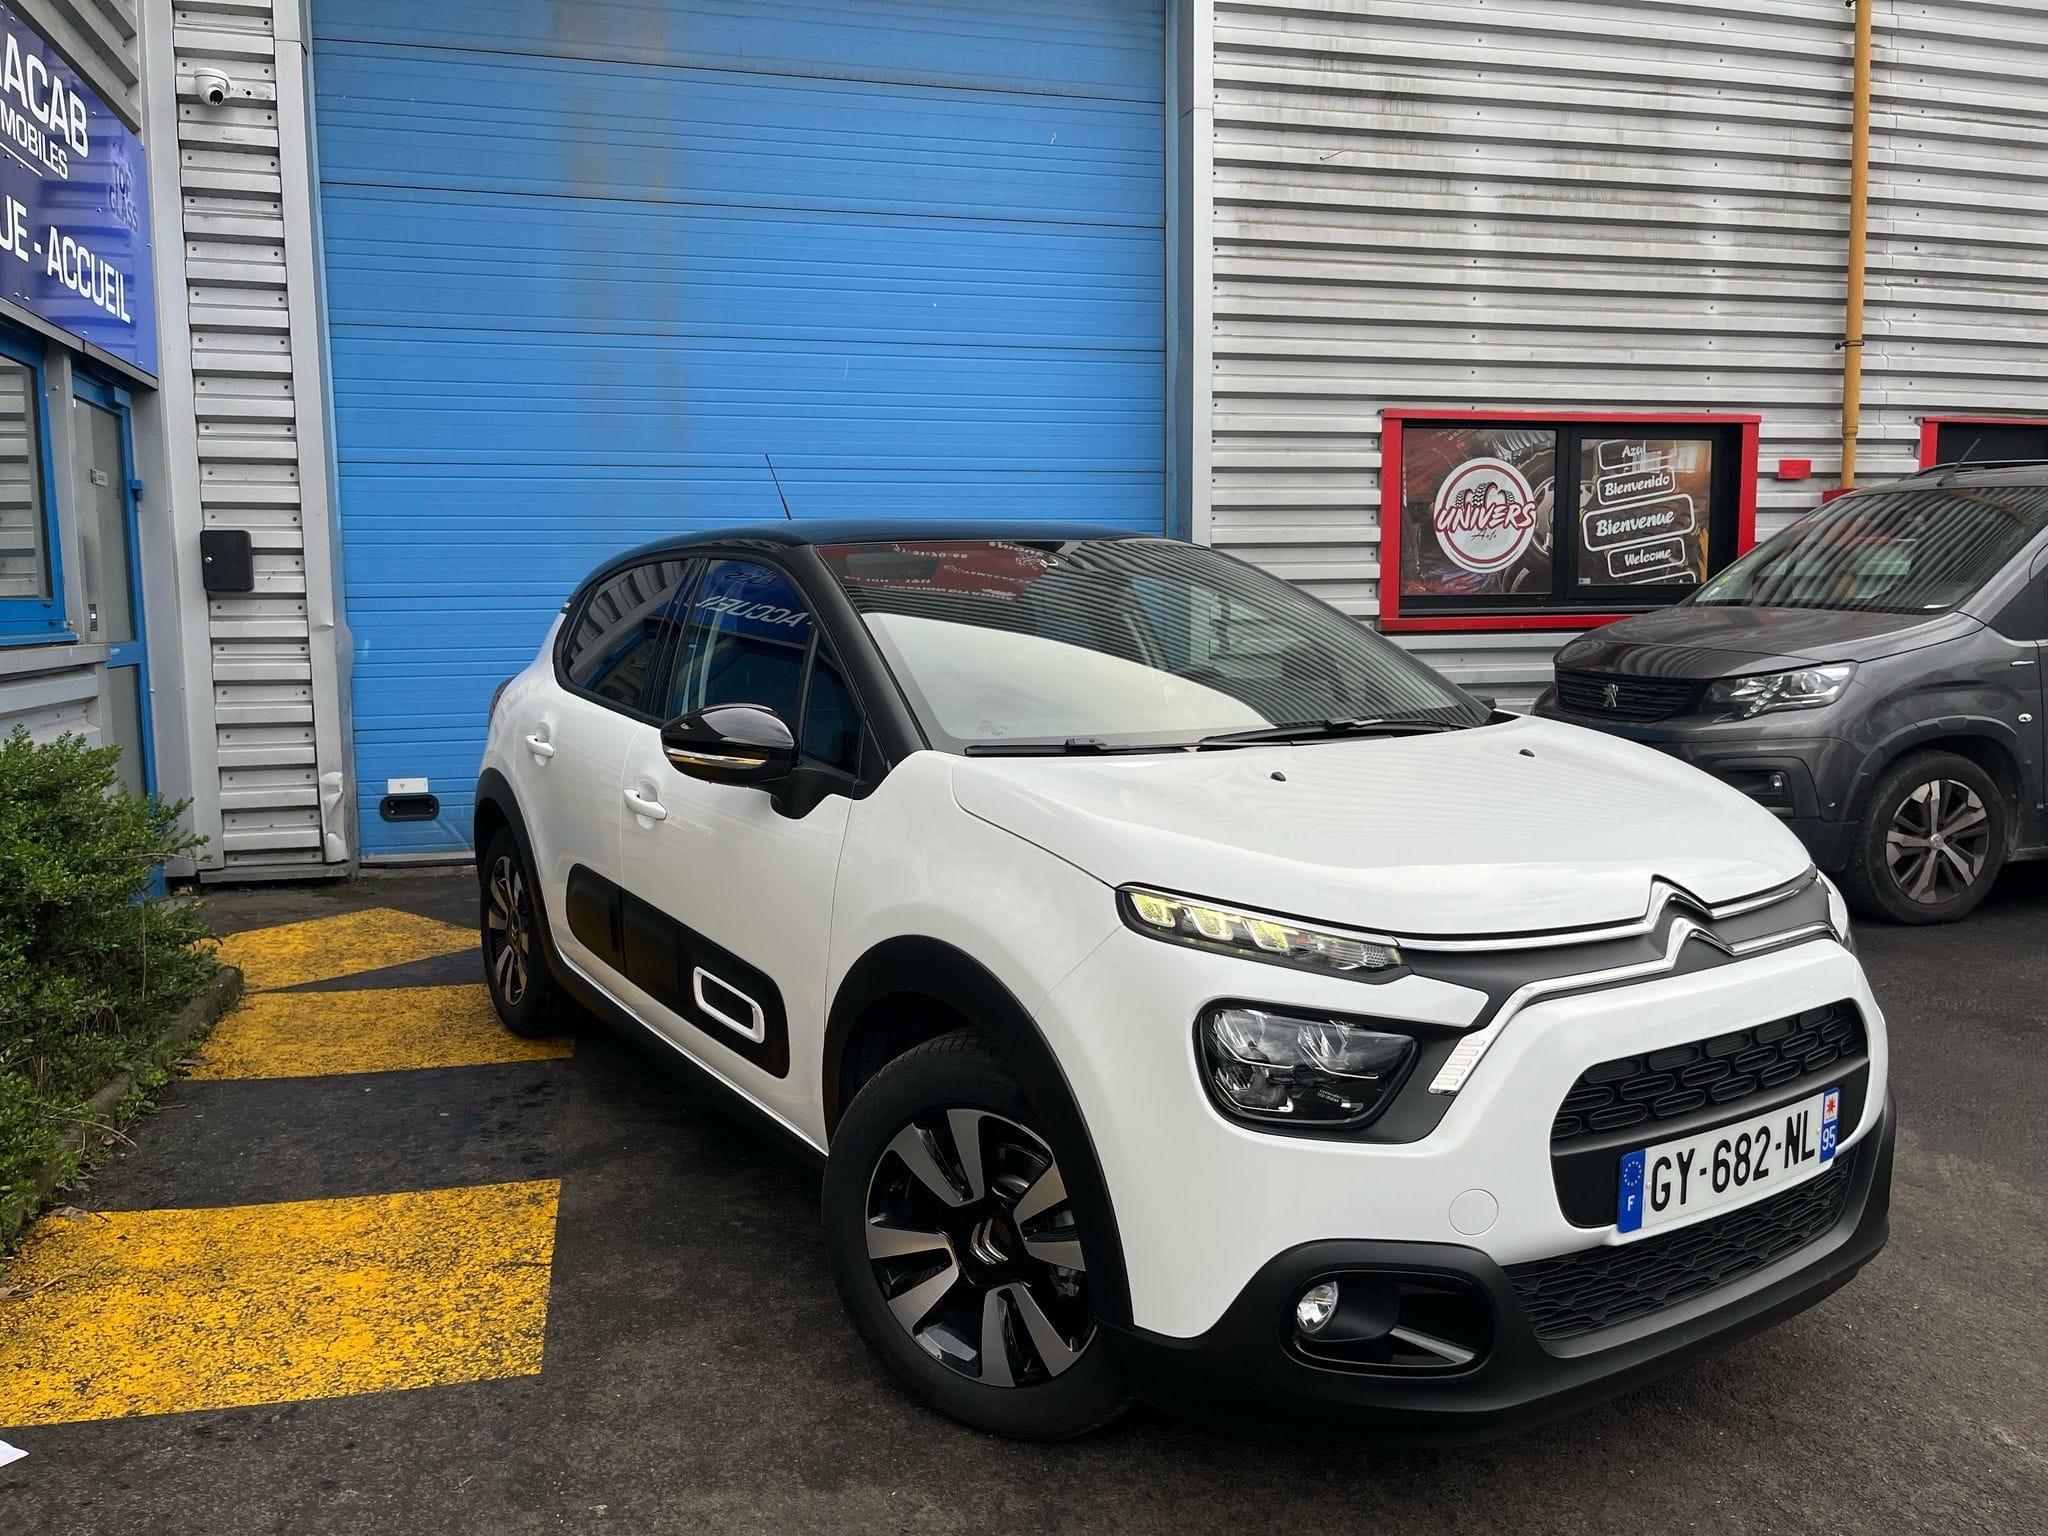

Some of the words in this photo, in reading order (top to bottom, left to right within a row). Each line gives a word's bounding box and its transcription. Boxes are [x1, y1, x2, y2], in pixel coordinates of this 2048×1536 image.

[0, 32, 88, 158] ACAB
[0, 99, 68, 180] MOBILES
[47, 225, 131, 324] ACCUEIL
[1604, 472, 1670, 496] Bienvenido
[1436, 501, 1537, 533] UNIVERS
[1596, 511, 1675, 537] Bienvenue
[1624, 549, 1671, 567] Welcome
[1822, 1125, 1836, 1151] 95
[1651, 1109, 1816, 1212] GY-682-NL
[1627, 1194, 1636, 1212] F
